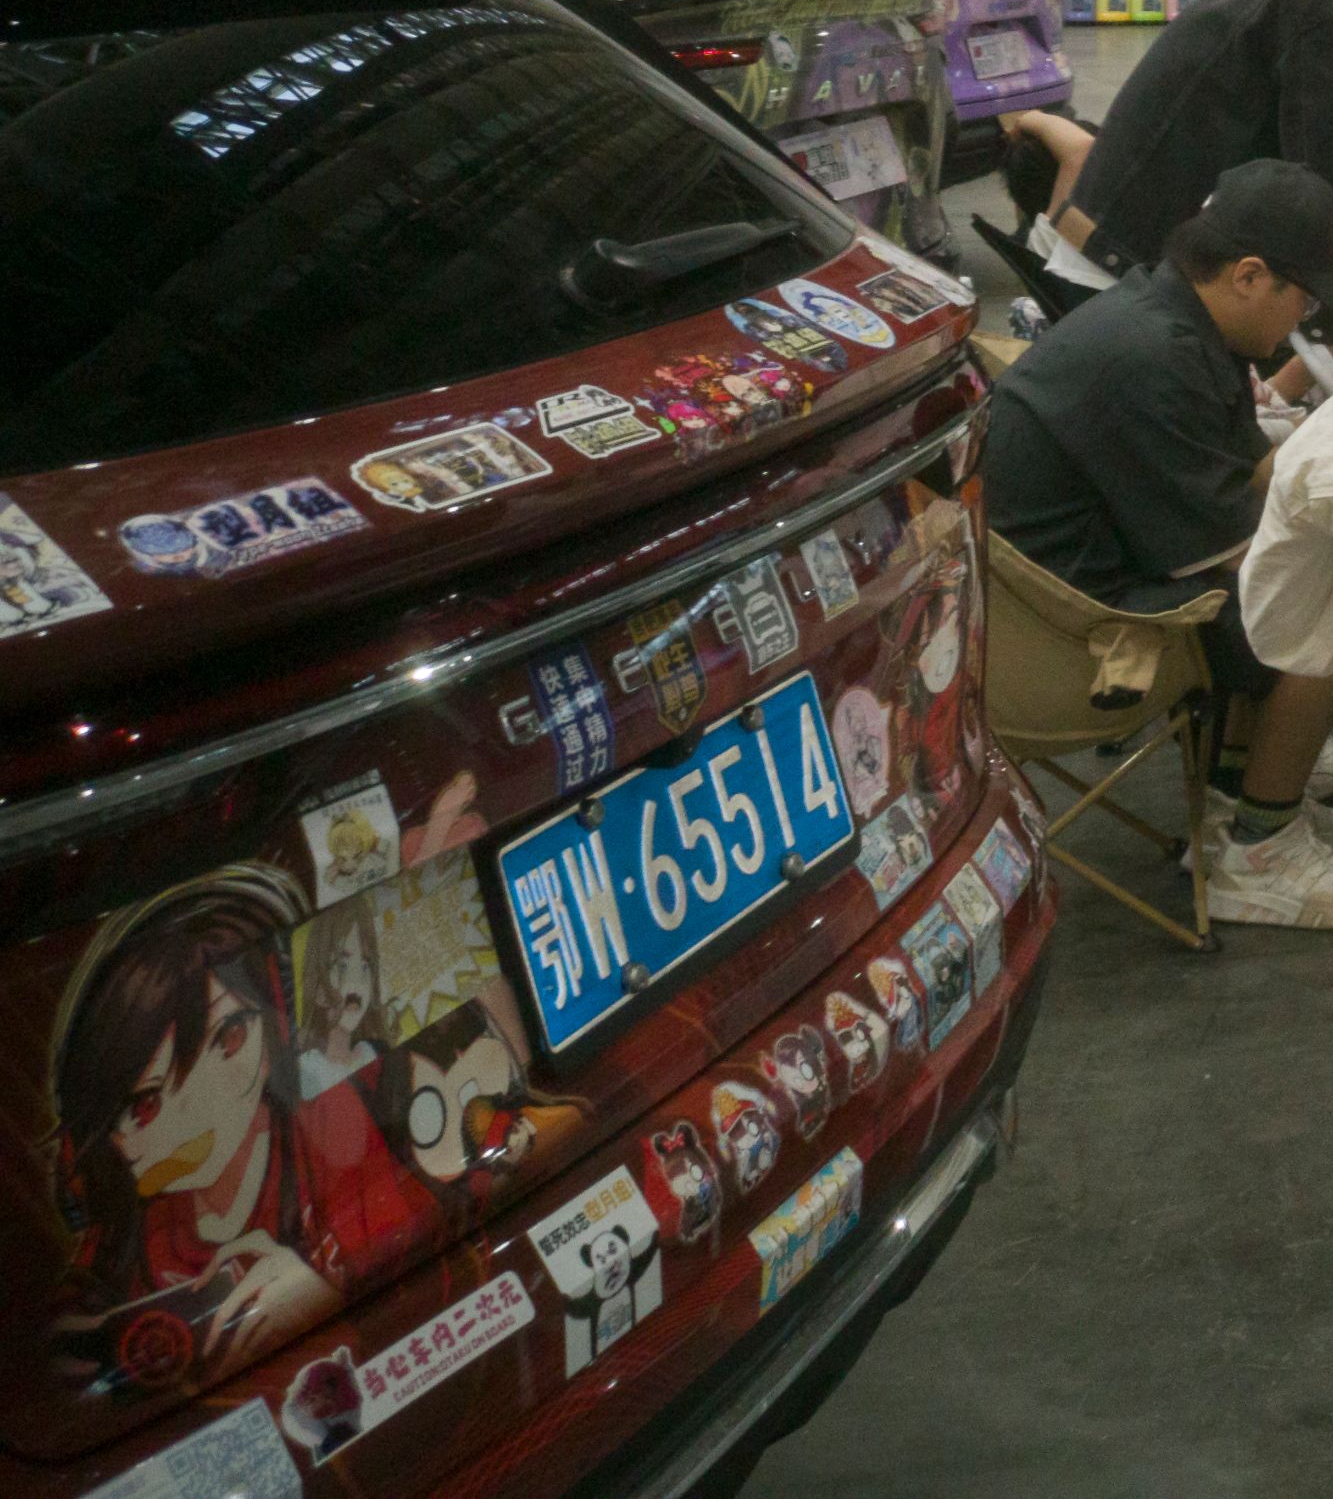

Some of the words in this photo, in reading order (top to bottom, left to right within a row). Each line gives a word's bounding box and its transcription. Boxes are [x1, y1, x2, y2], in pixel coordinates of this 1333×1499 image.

[537, 664, 587, 791] 快速通过
[563, 652, 609, 779] 集中精力
[515, 702, 838, 1010] 鄂W·65514
[362, 1278, 524, 1402] 当心车内二次元
